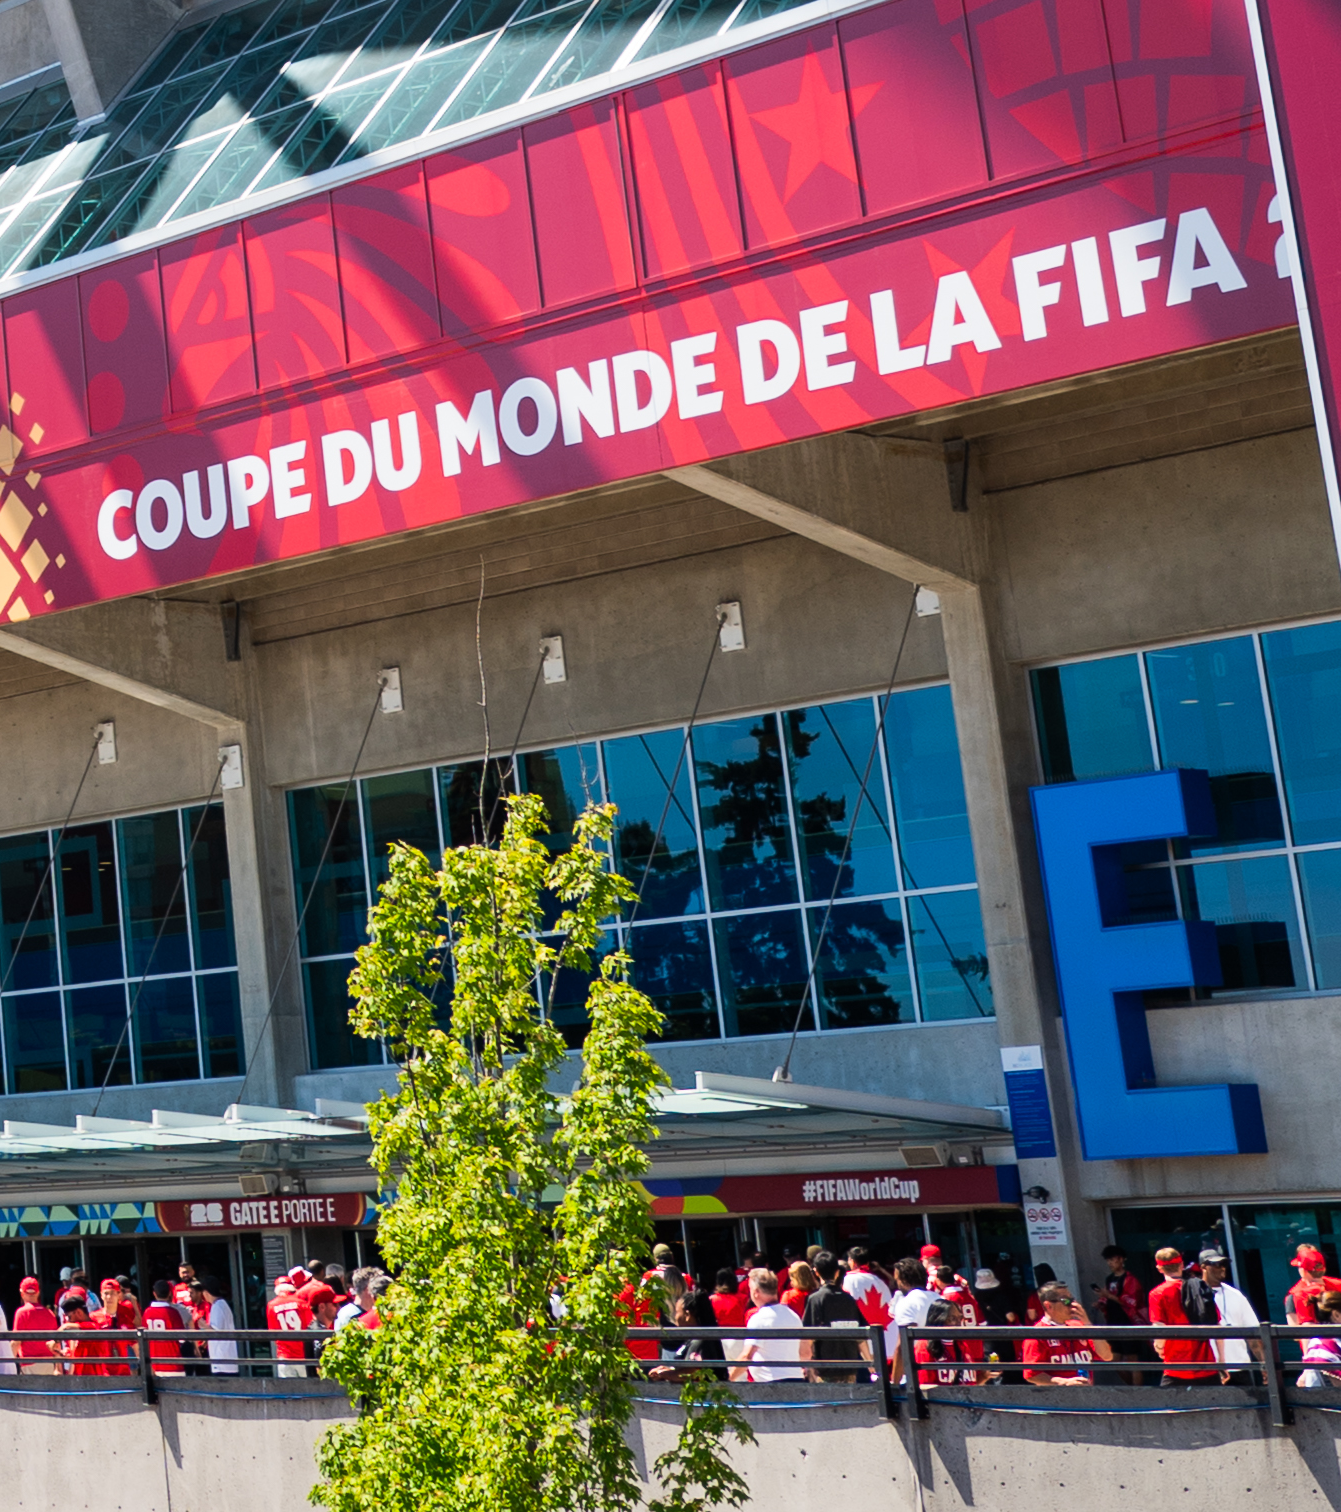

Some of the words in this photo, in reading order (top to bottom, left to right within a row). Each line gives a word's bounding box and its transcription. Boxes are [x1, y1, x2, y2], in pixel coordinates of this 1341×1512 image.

[97, 440, 313, 561] COUPE
[321, 410, 423, 508] DU
[435, 331, 724, 478] MONDE
[736, 299, 857, 406] DE
[869, 270, 1003, 376] LA
[1012, 206, 1248, 343] FIFA
[1029, 767, 1268, 1162] E
[229, 1200, 268, 1226] GATE
[269, 1200, 280, 1224] E
[282, 1198, 325, 1224] PORTE
[326, 1197, 336, 1222] E
[802, 1177, 920, 1203] #FIFAWorldCup
